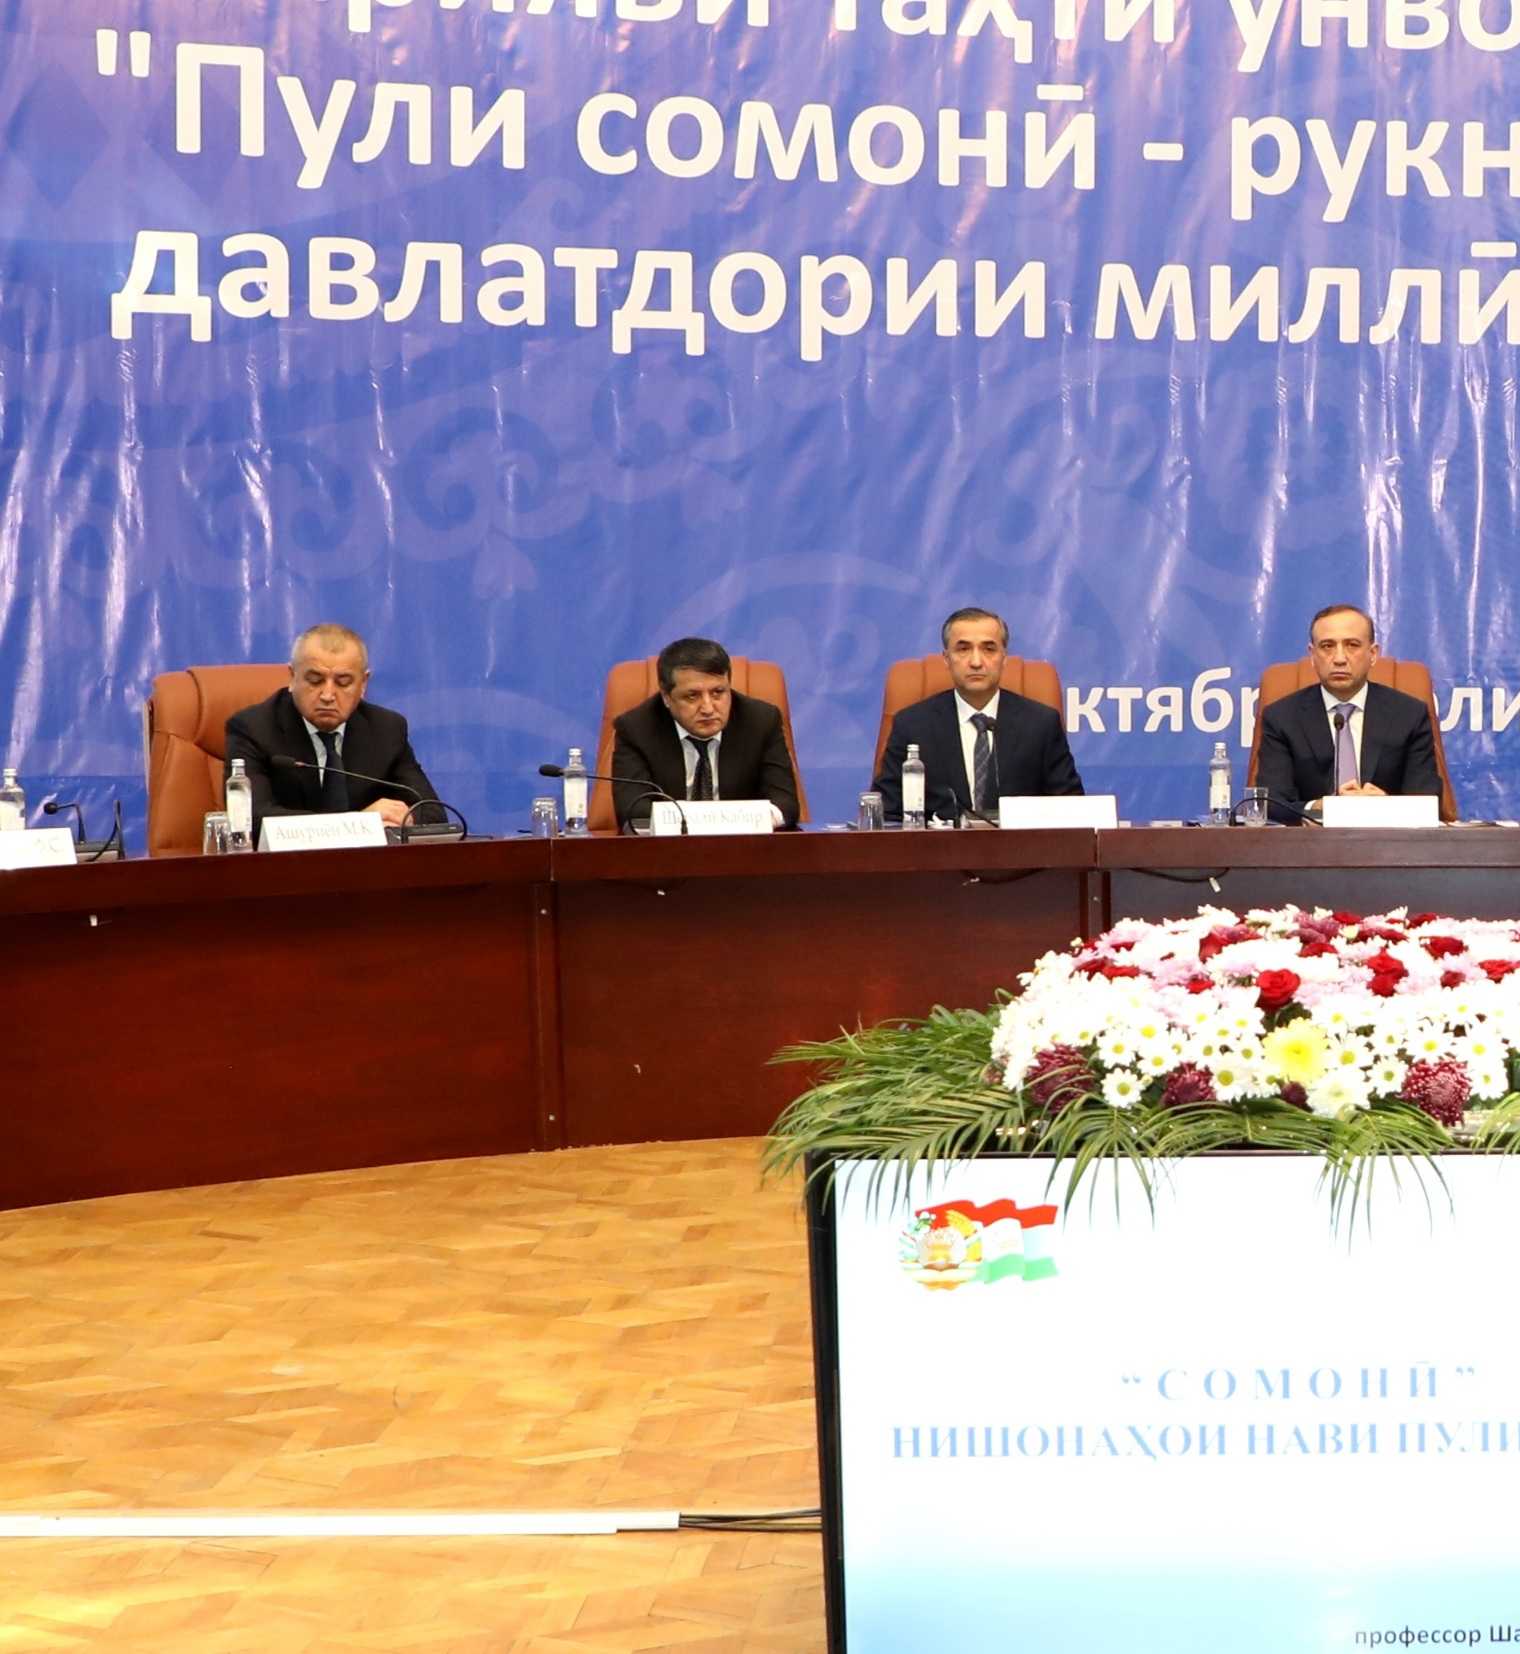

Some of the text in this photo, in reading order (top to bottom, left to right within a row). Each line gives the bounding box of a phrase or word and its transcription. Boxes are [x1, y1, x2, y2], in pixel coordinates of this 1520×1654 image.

[96, 29, 525, 189] "Пули
[577, 84, 1095, 190] сомонӣ
[1143, 142, 1184, 161] -
[111, 230, 1045, 361] давлатдории
[1246, 1422, 1378, 1456] НАВИ
[1354, 1625, 1482, 1648] профессор
